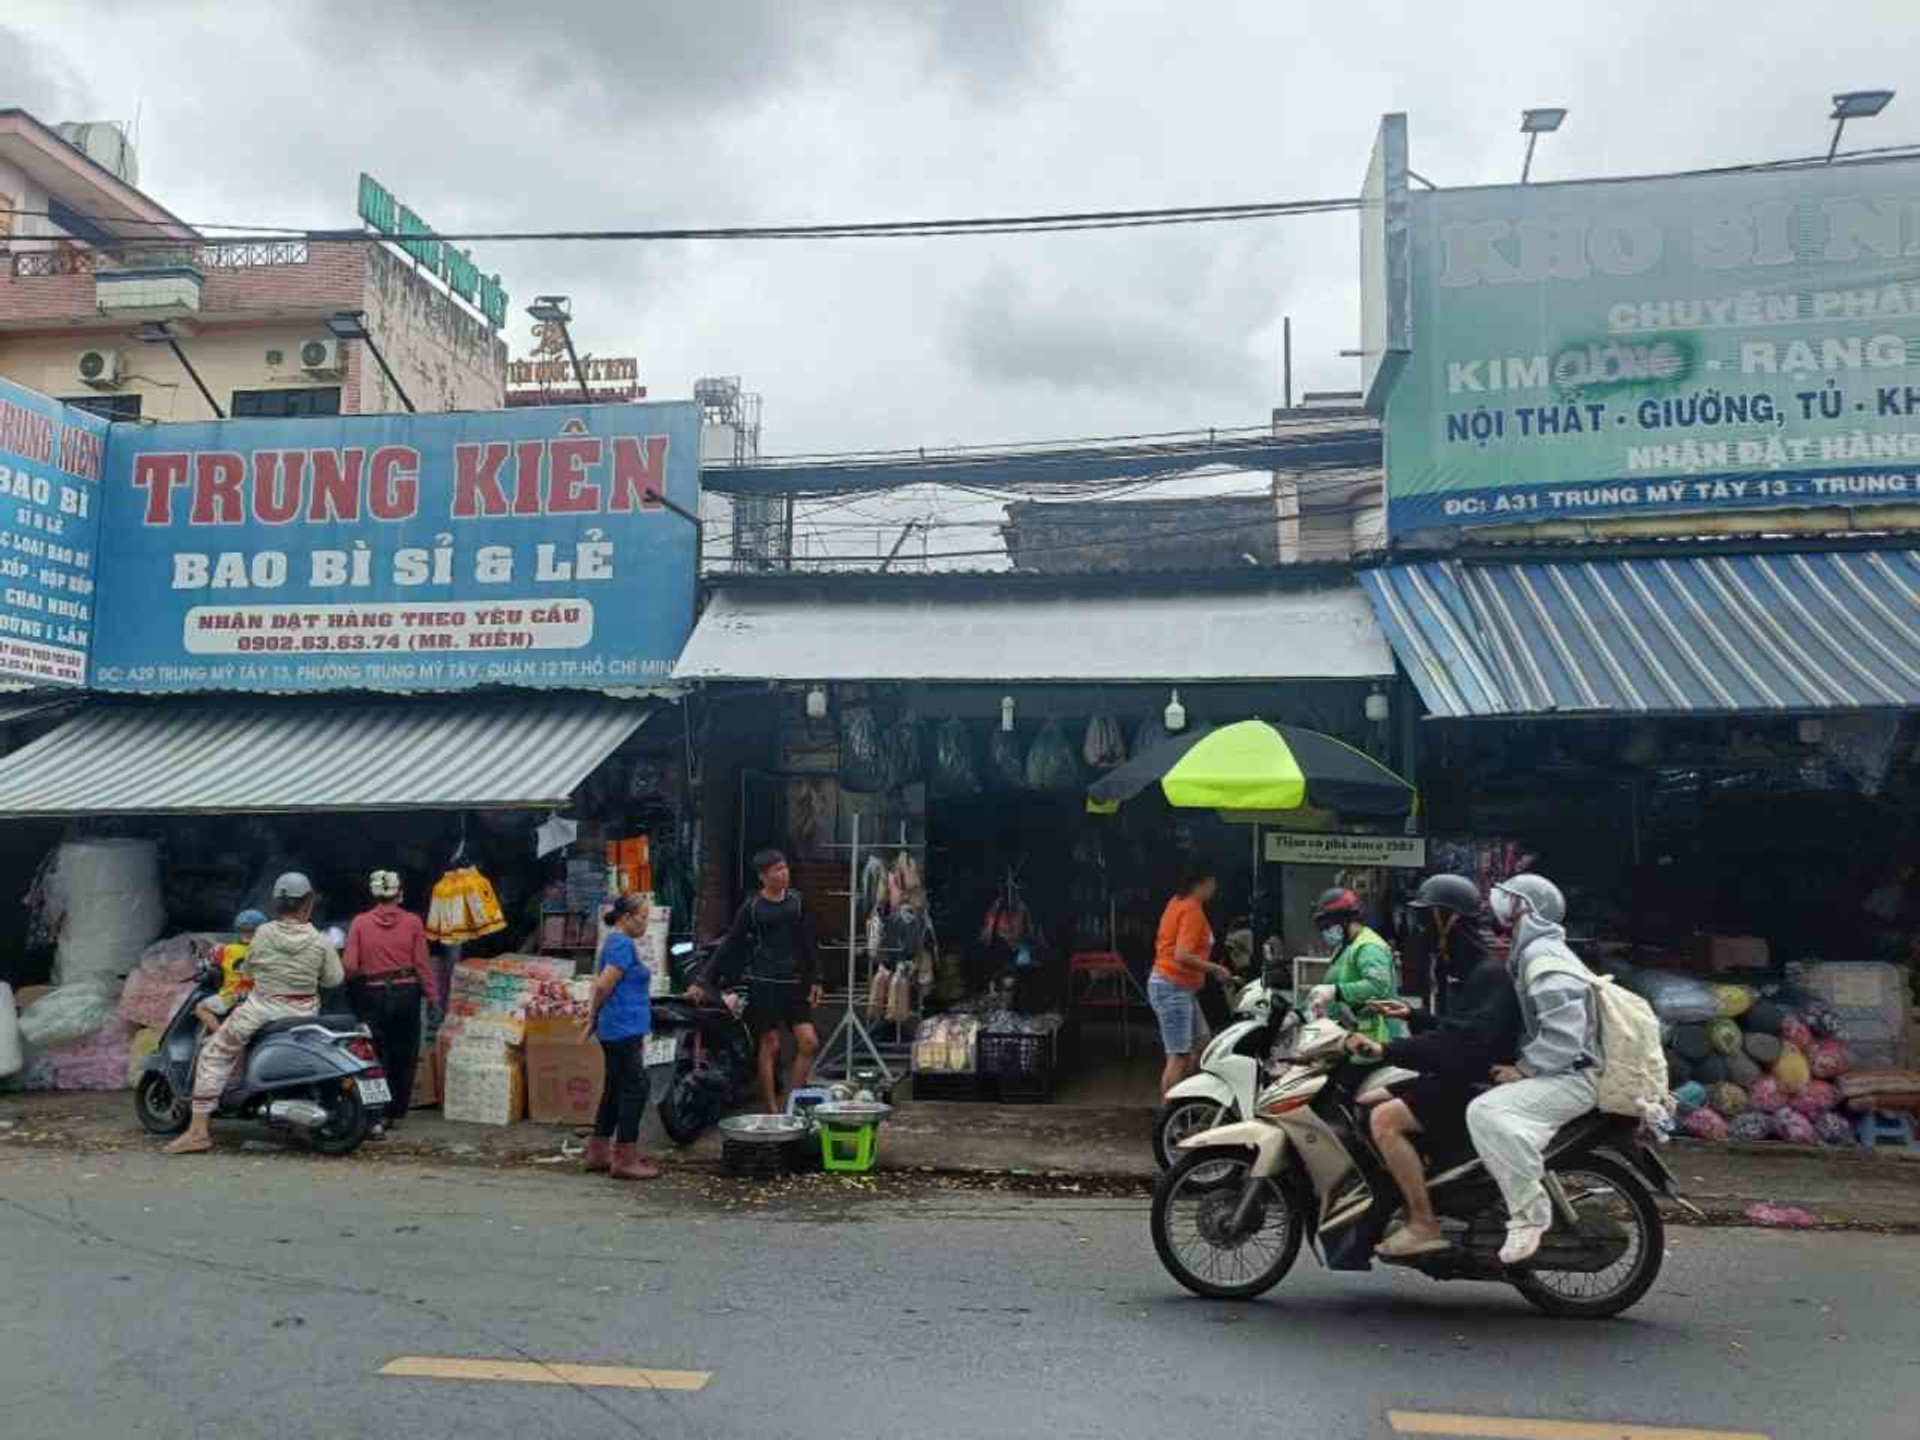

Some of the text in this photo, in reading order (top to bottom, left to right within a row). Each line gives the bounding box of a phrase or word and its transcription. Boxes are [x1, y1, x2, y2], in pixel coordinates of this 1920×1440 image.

[1440, 216, 1663, 287] KHO
[1822, 195, 1920, 263] N
[1812, 281, 1920, 320] PHÂ
[1448, 355, 1549, 393] KIM
[1447, 405, 1503, 448] NỘI
[1515, 390, 1606, 436] THẤT
[1638, 388, 1784, 428] GIƯỜNG,
[1796, 378, 1842, 419] TỦ
[132, 418, 671, 526] TRUNG KIÊN
[60, 486, 88, 519] BÌ
[1494, 493, 1539, 513] A31
[1548, 486, 1638, 509] TRUNG
[1646, 480, 1685, 502] MỸ
[1759, 479, 1788, 496] 13
[1812, 474, 1907, 493] TRUNG
[172, 528, 613, 589] BAO BÌ SỈ & LẺ
[198, 611, 264, 632] NHẬN
[400, 611, 466, 627] THEO
[408, 632, 460, 650] (MR.
[157, 664, 207, 682] TRUNG
[367, 661, 416, 680] TRUNG
